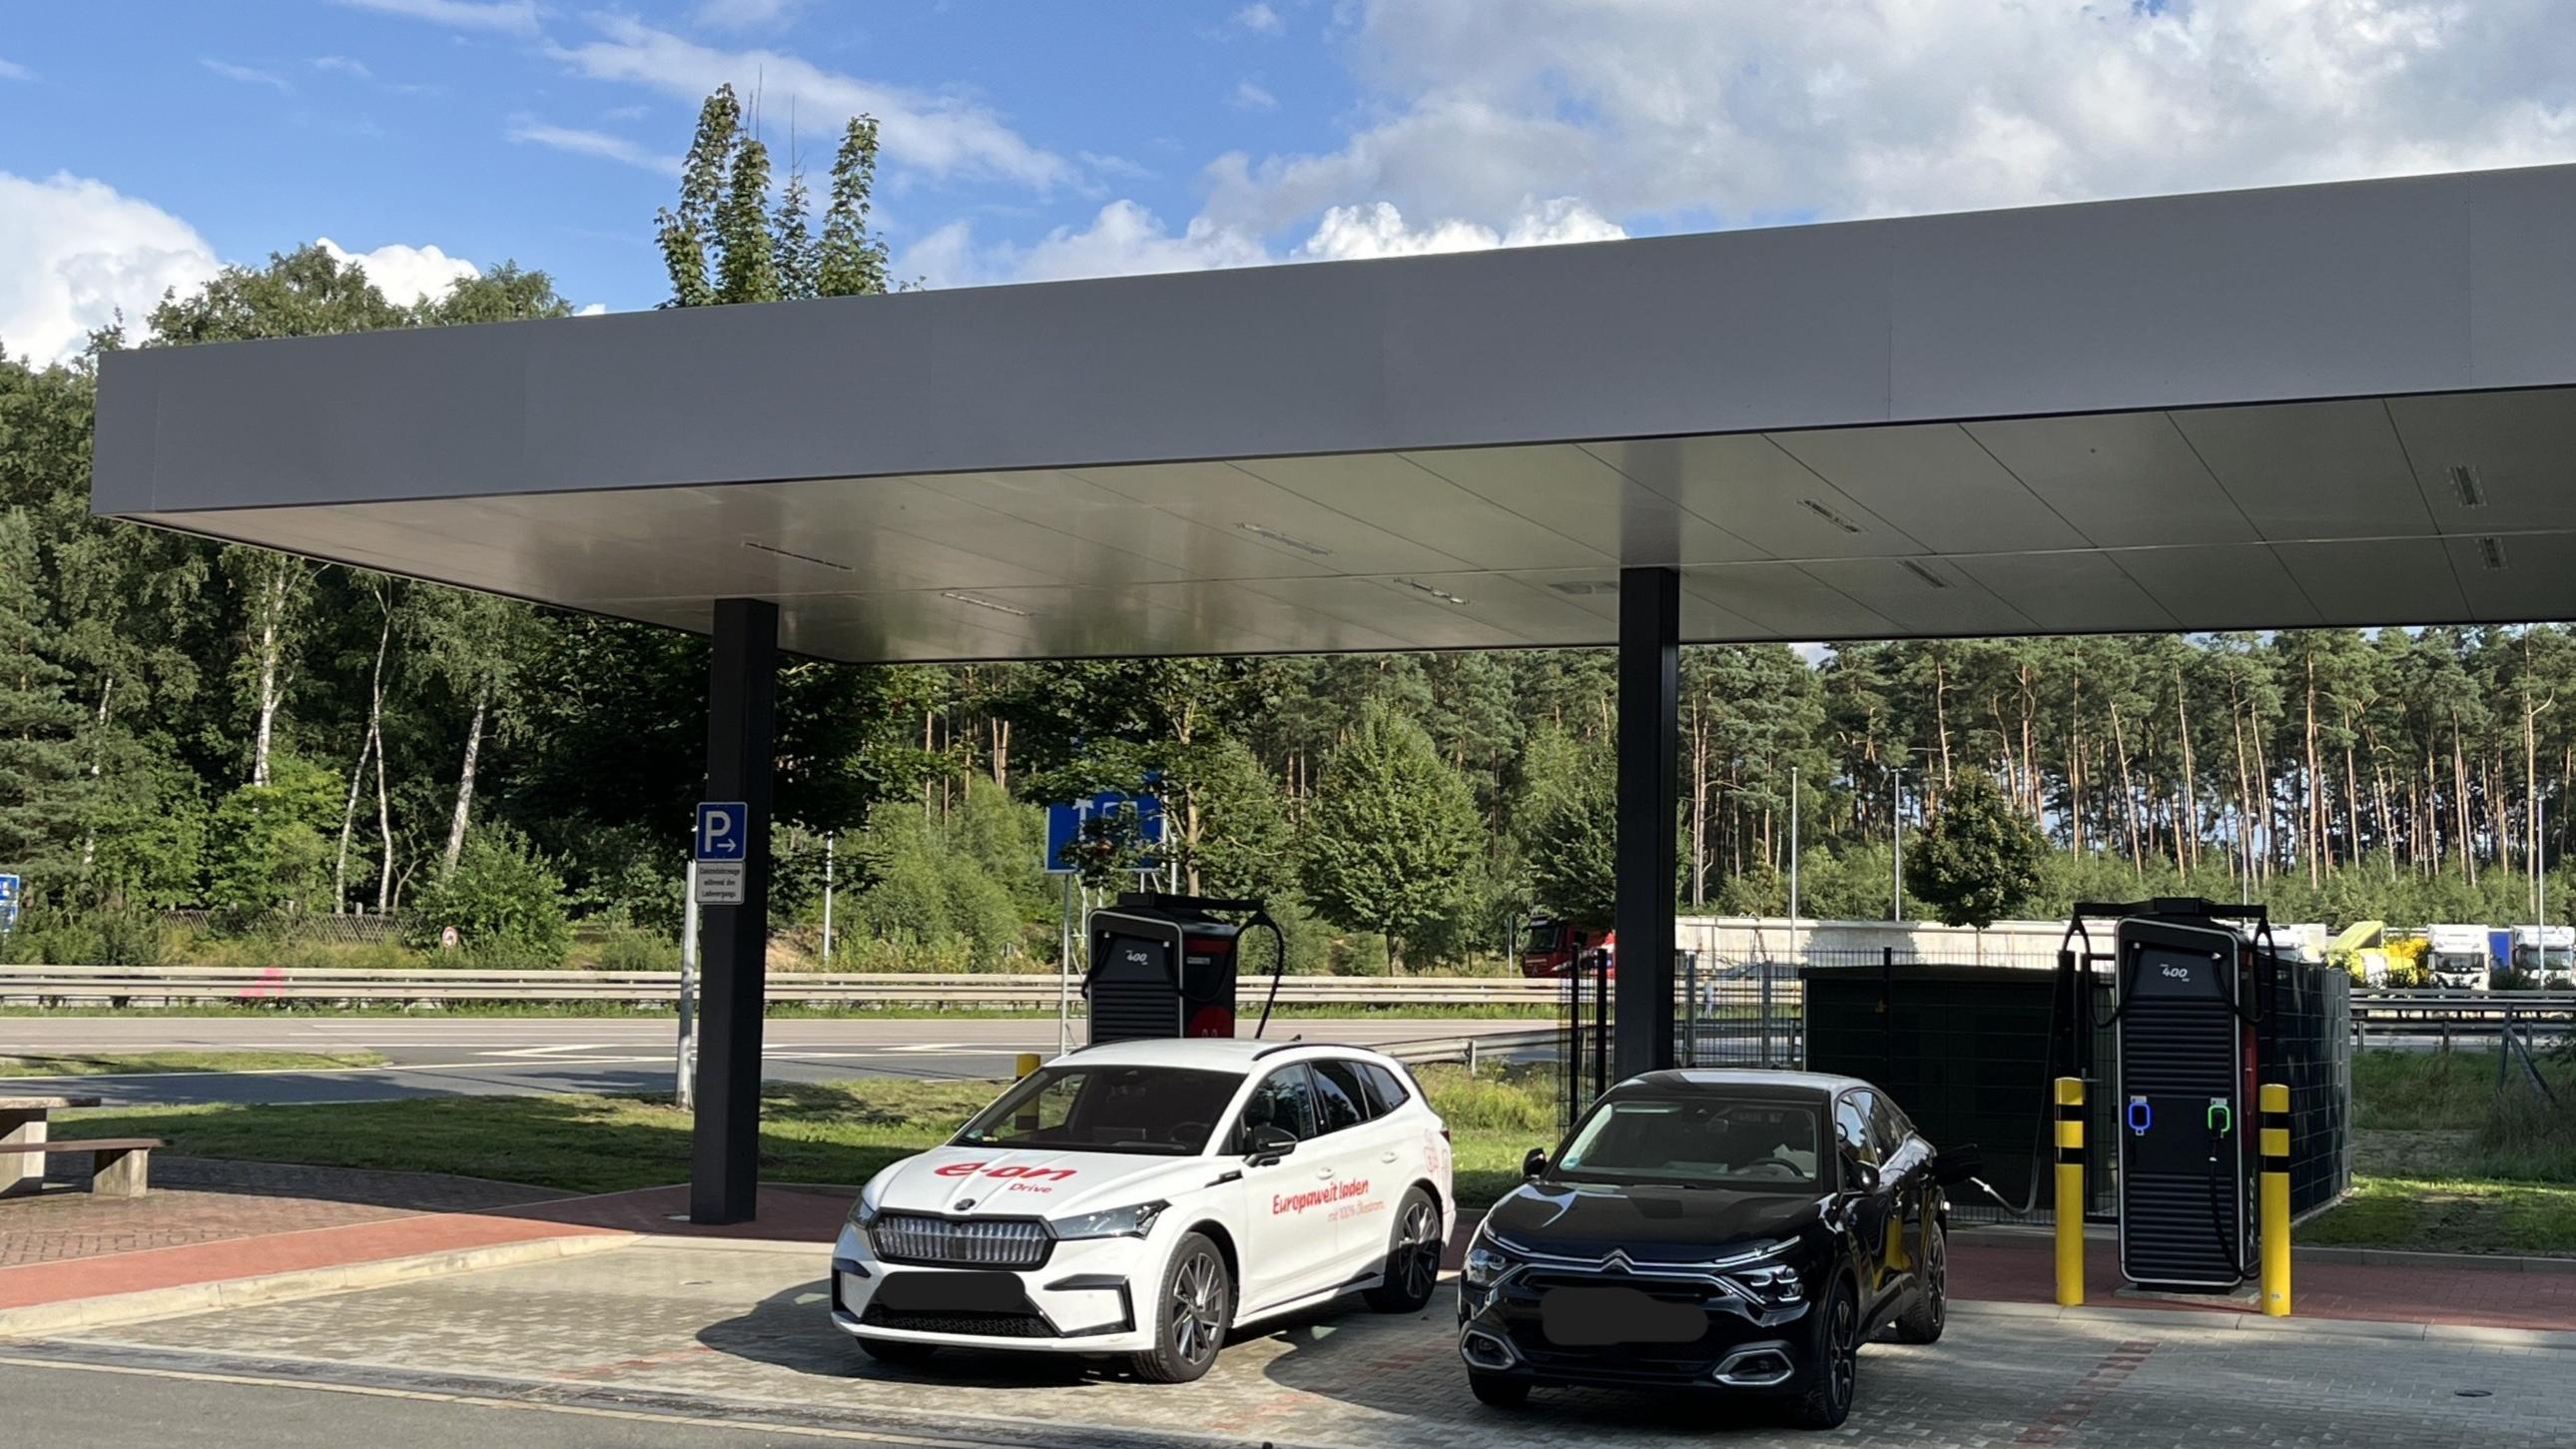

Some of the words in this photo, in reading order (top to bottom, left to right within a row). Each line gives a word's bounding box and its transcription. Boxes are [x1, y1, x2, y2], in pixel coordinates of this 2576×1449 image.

[705, 811, 731, 852] P
[2162, 967, 2188, 978] 400
[1007, 1182, 1053, 1193] Drive
[1272, 1182, 1337, 1215] Europaweit
[1339, 1177, 1369, 1200] laden
